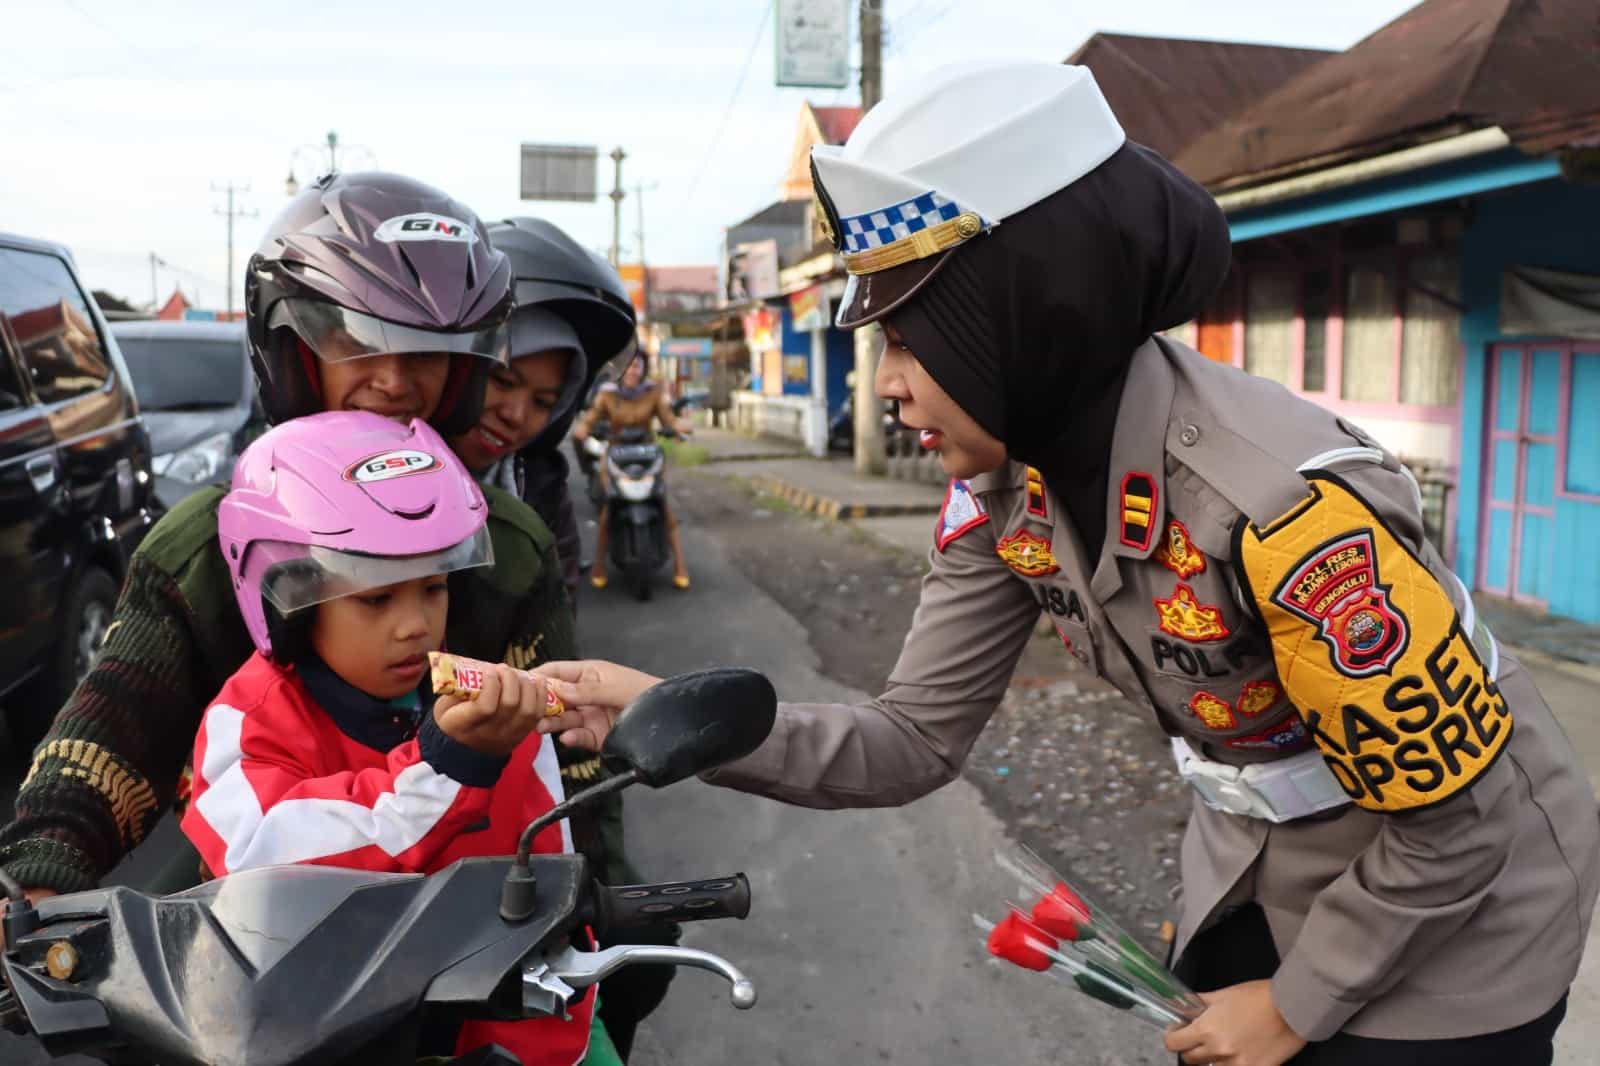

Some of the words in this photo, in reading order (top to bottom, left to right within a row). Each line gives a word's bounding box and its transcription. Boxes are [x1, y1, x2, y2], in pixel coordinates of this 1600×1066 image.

[401, 219, 462, 236] GM
[366, 456, 422, 473] GSP
[1314, 573, 1367, 613] BENGKULU
